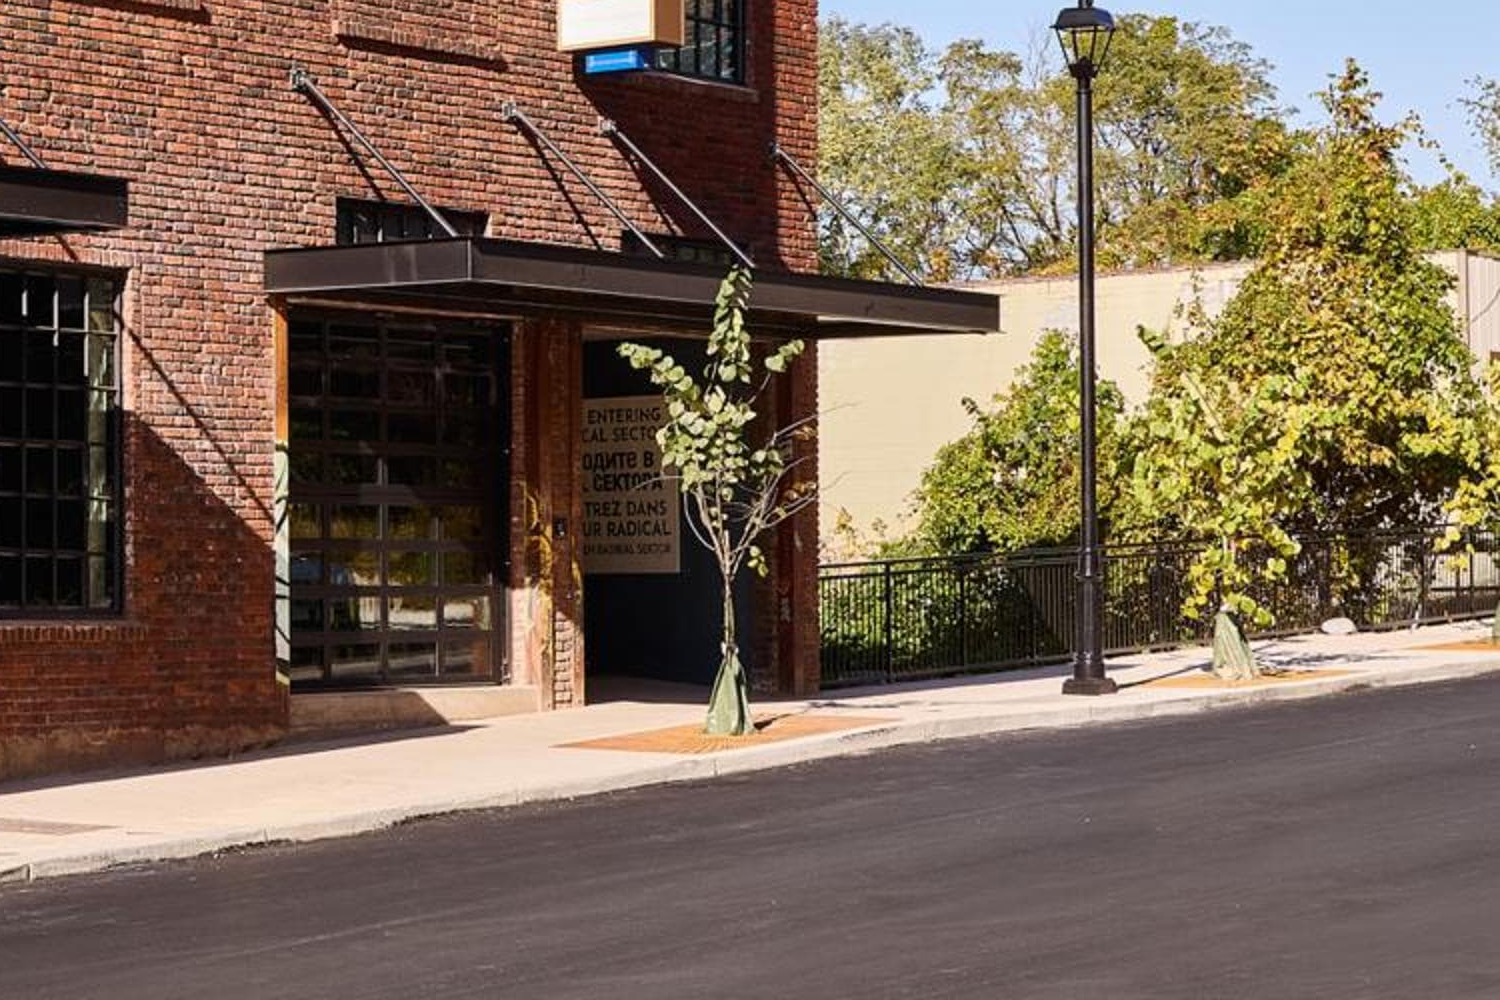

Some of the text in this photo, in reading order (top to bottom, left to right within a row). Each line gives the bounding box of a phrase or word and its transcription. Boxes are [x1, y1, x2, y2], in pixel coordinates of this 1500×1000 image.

[587, 407, 661, 424] ENTERING
[612, 425, 663, 441] SECTO
[627, 500, 667, 517] DANS
[607, 520, 672, 536] RADICAL
